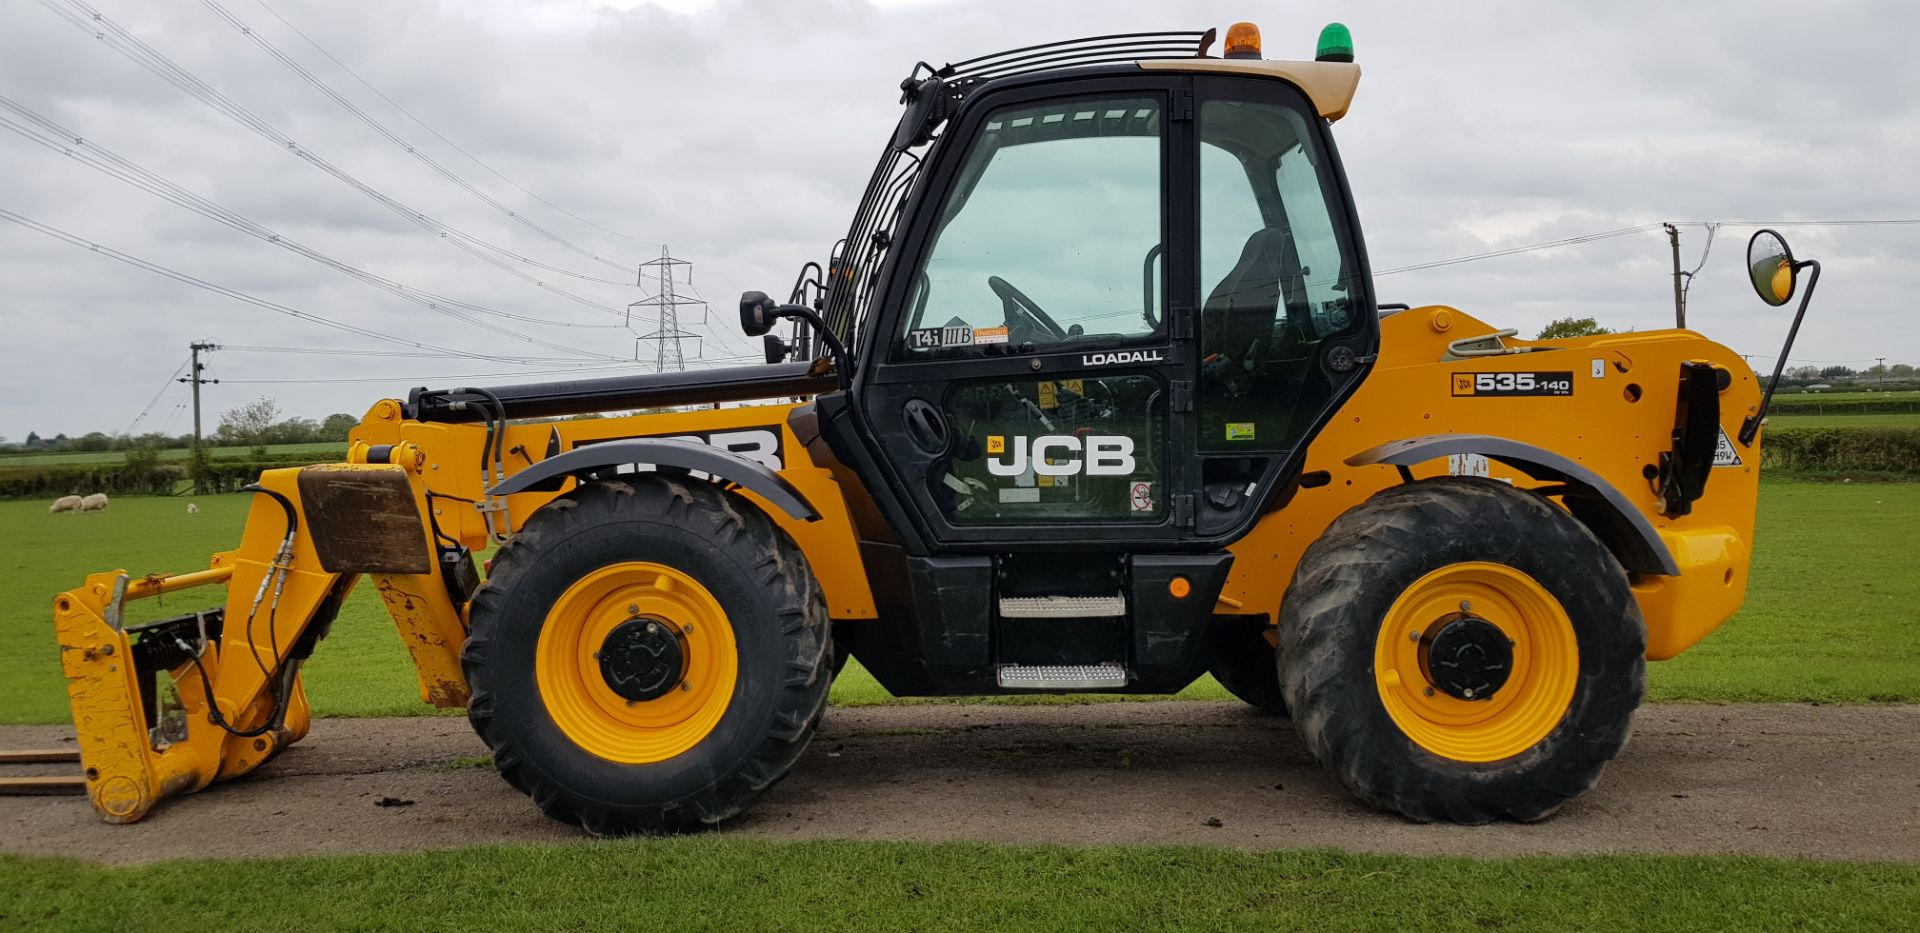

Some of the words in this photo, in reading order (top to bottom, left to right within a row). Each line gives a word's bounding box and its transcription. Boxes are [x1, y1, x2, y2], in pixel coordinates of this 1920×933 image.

[911, 329, 941, 347] T4i
[1082, 350, 1164, 366] LOADALL
[1475, 373, 1570, 391] 535-140
[987, 435, 1136, 476] JCB
